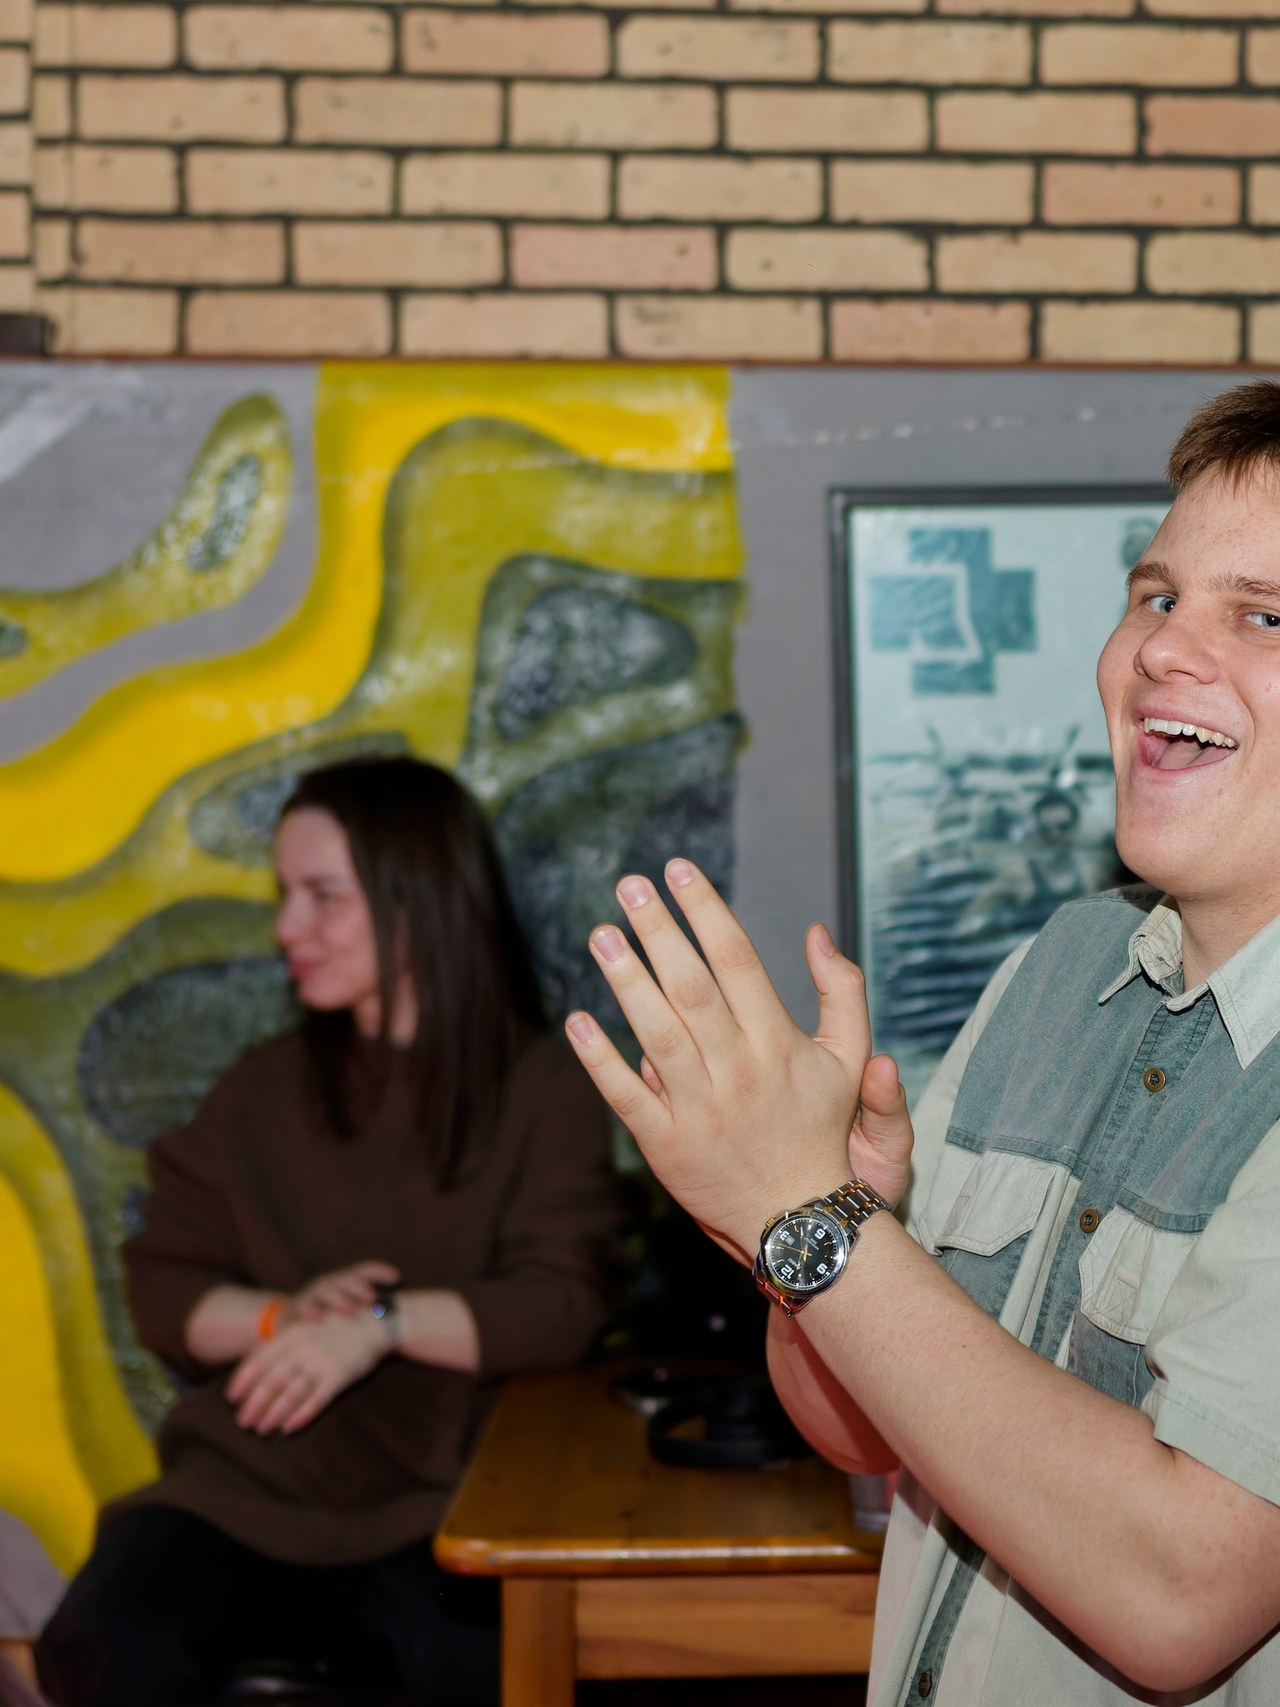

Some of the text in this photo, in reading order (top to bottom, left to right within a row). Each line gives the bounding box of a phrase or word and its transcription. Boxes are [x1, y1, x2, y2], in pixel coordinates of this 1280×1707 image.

[780, 1231, 789, 1240] 3
[814, 1228, 825, 1239] 6
[781, 1264, 794, 1279] 12
[816, 1264, 827, 1274] 9
